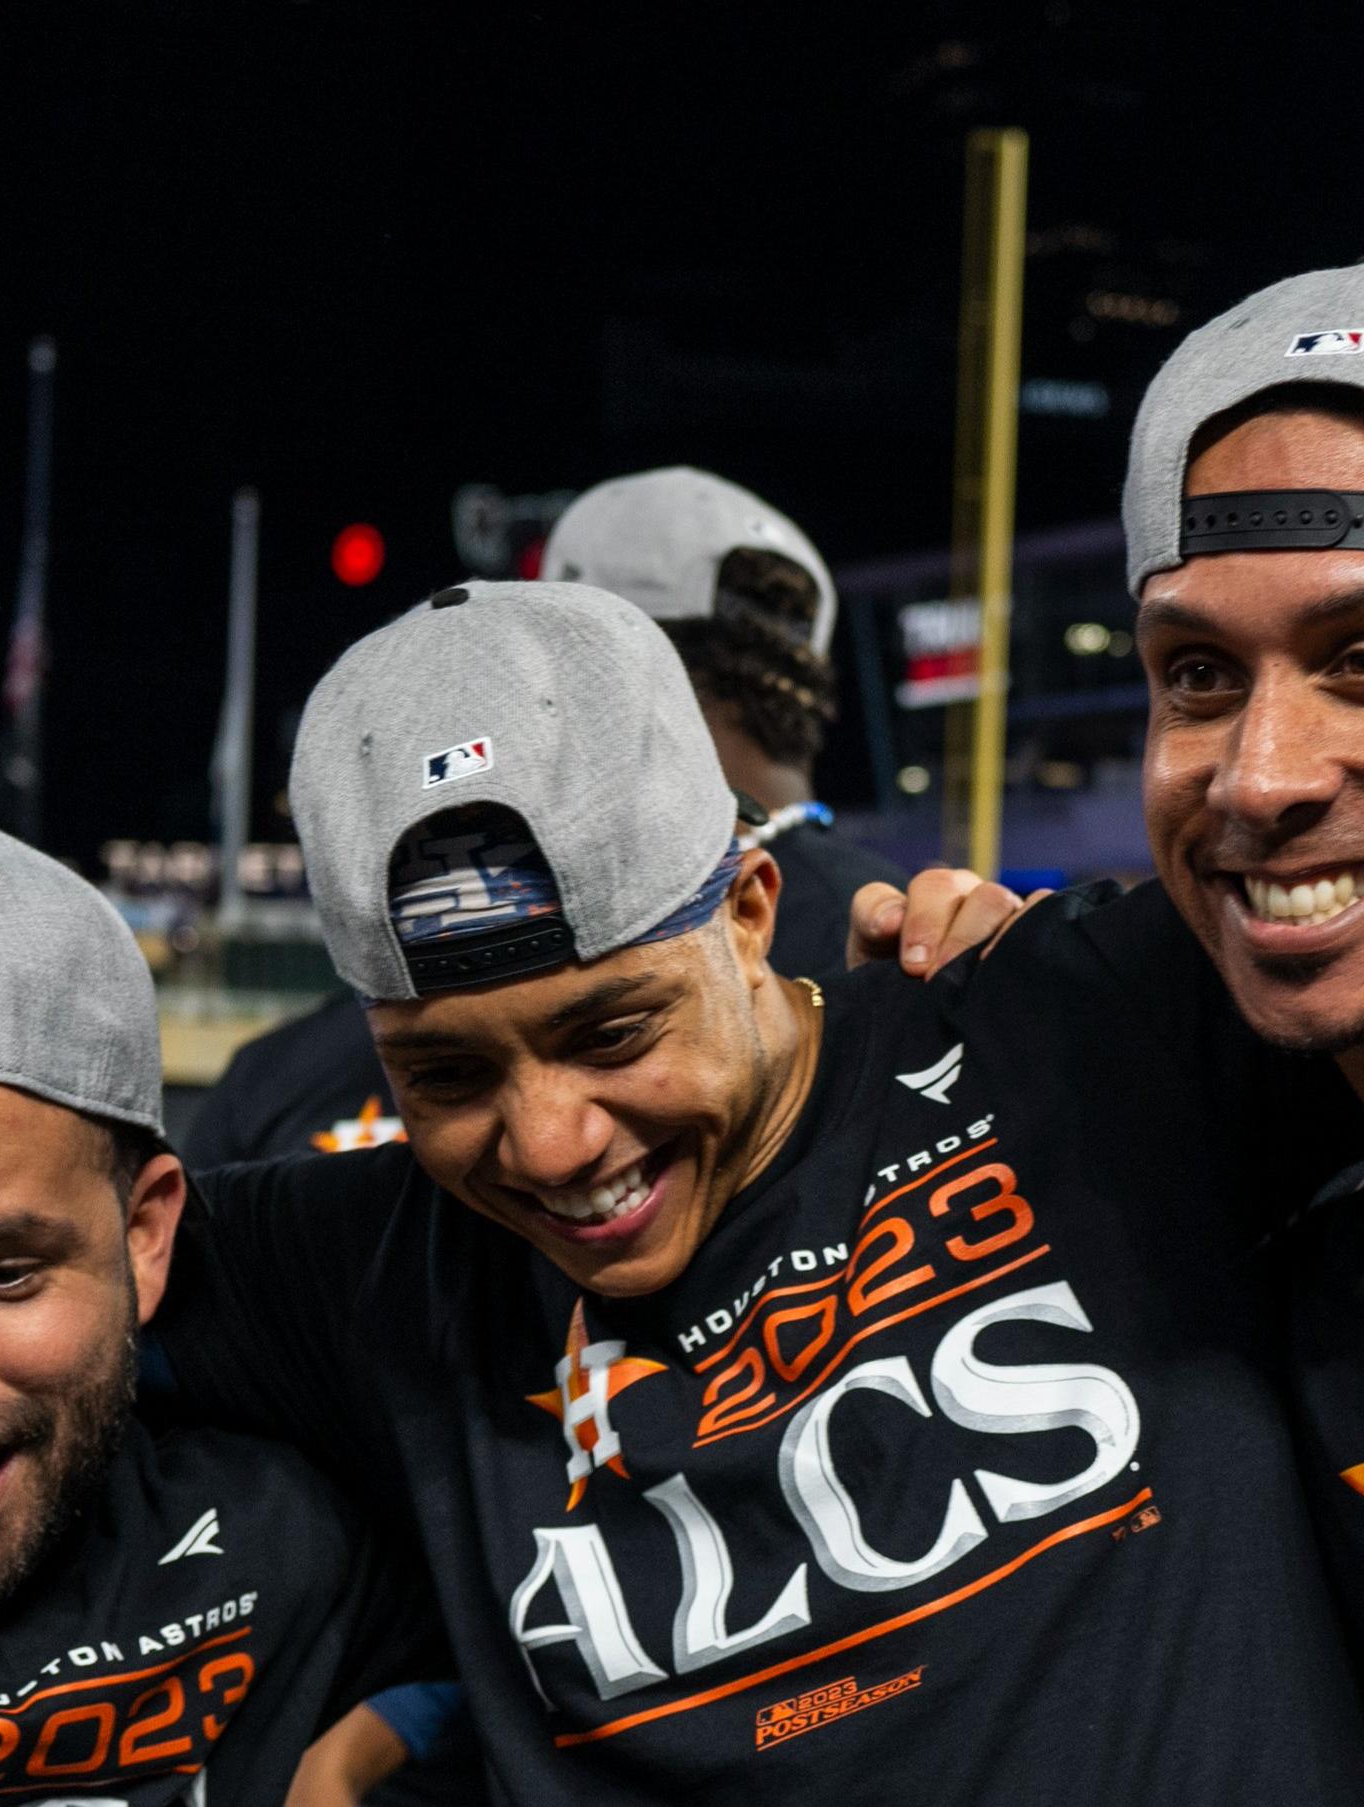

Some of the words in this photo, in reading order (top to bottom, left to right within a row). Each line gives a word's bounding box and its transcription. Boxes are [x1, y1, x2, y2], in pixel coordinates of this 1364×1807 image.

[677, 1243, 849, 1353] HOUSTON
[864, 1113, 995, 1206] TROS
[696, 1162, 1035, 1437] 2023
[508, 1280, 1141, 1710] ALCS
[755, 1665, 924, 1746] POSTSEASON
[797, 1680, 859, 1711] 2023
